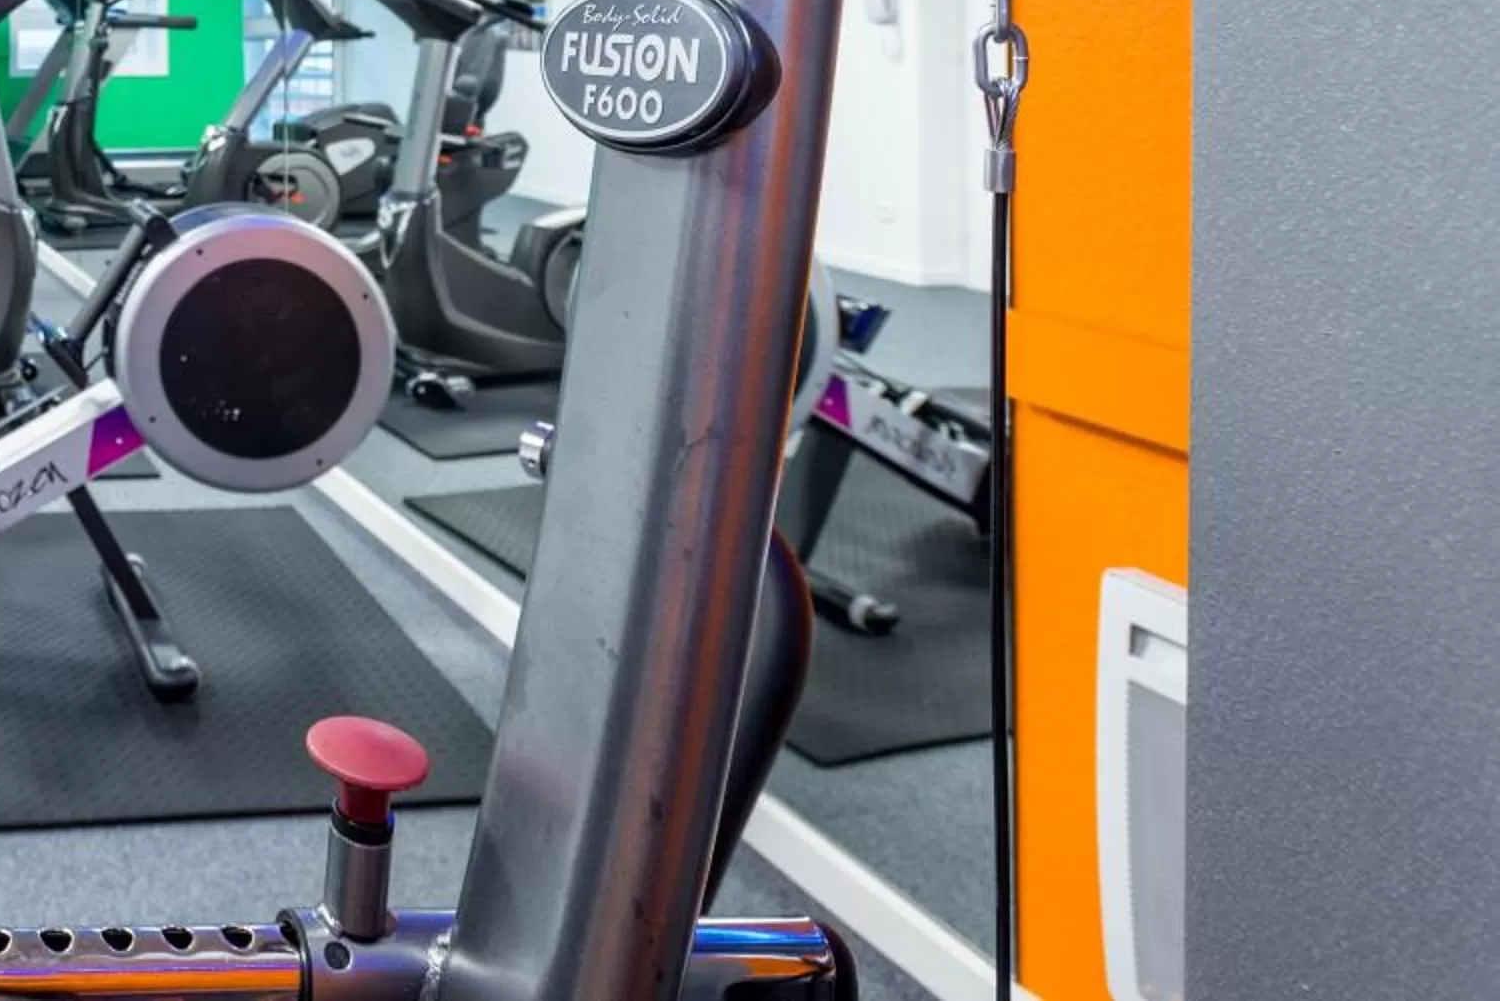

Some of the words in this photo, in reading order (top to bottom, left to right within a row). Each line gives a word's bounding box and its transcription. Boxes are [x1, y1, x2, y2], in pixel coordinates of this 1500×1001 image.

[582, 3, 684, 31] Body-Solid
[560, 31, 700, 84] FUSION
[583, 84, 663, 125] F600
